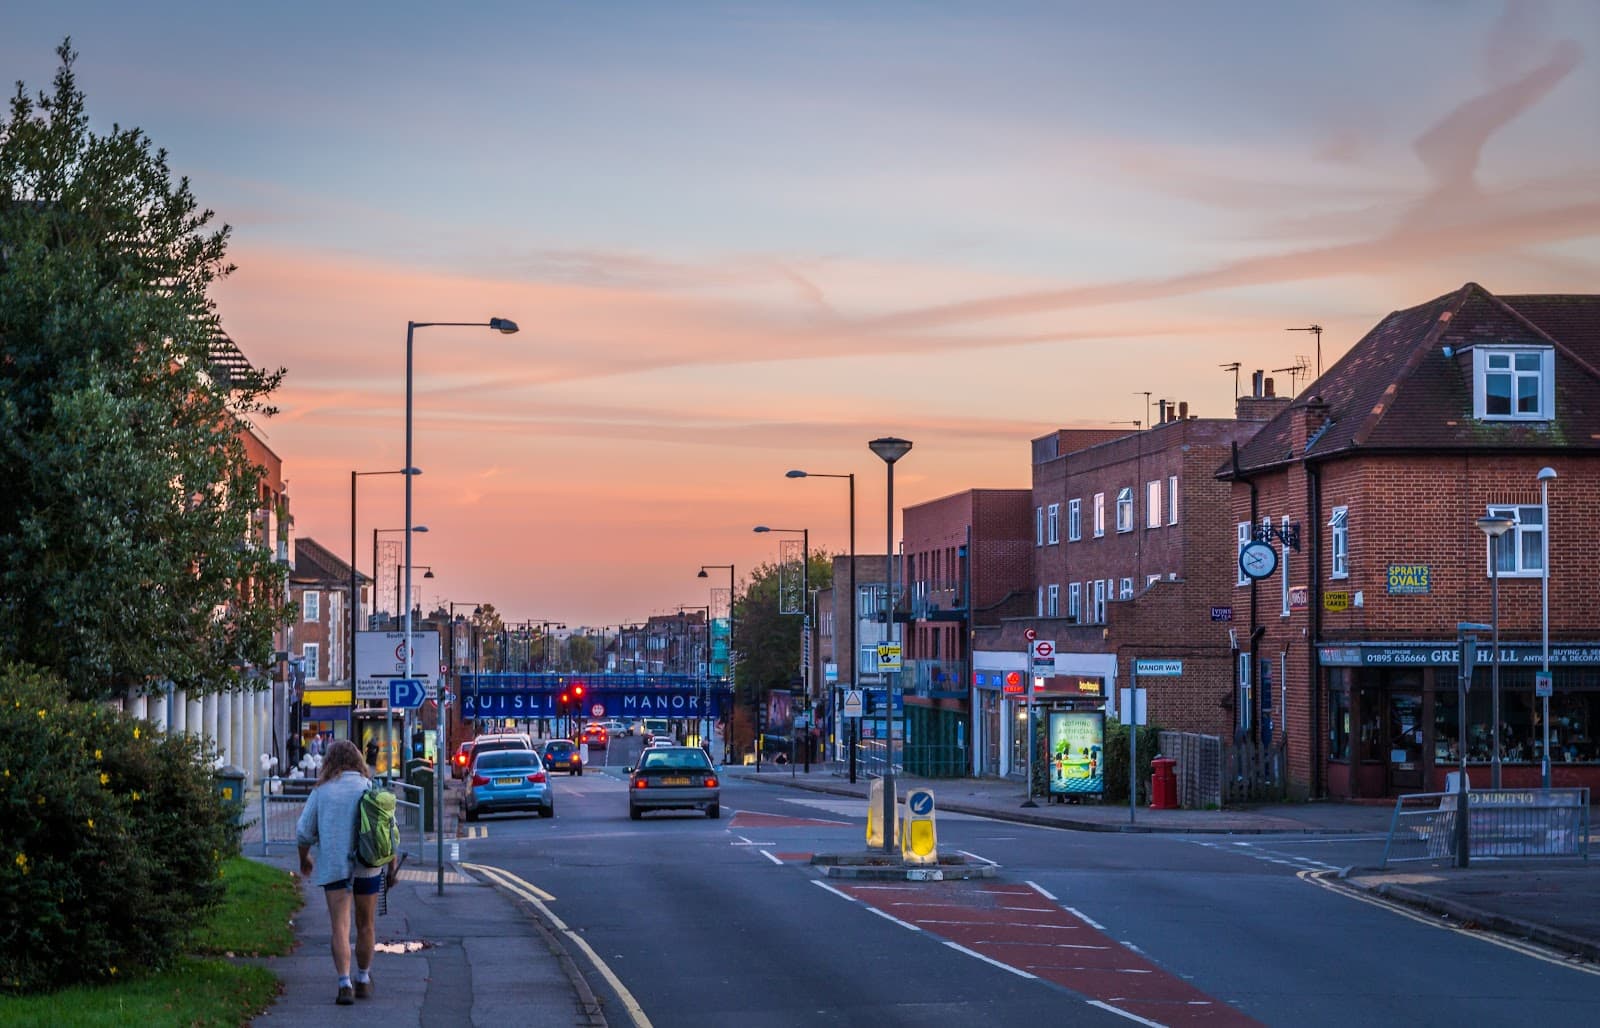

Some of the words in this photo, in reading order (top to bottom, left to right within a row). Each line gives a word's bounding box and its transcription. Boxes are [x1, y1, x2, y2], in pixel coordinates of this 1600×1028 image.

[1389, 575, 1428, 586] OVALS
[1367, 654, 1391, 662] 01895
[1394, 654, 1426, 662] 636666
[396, 685, 410, 704] P
[624, 695, 698, 709] MANOR
